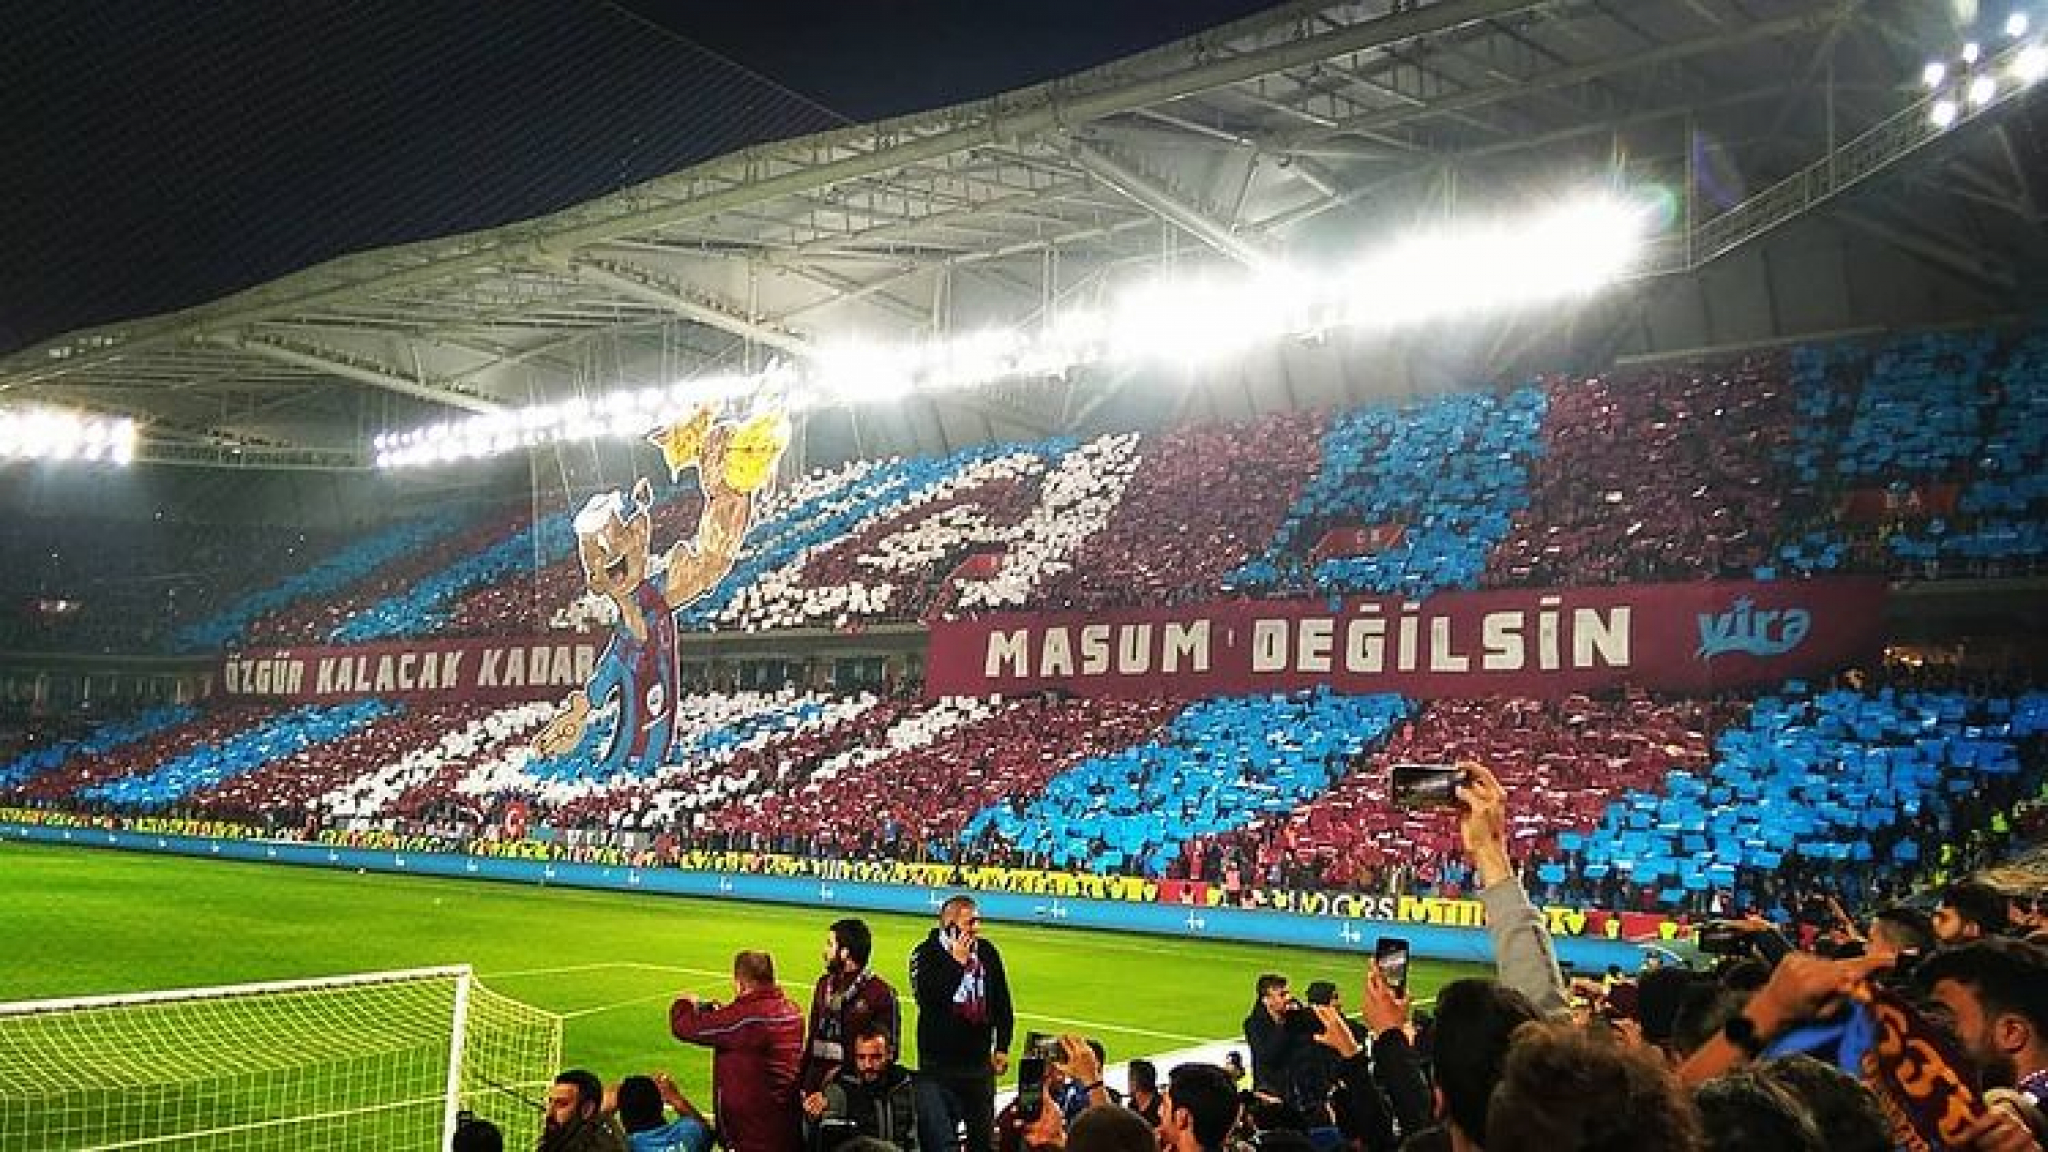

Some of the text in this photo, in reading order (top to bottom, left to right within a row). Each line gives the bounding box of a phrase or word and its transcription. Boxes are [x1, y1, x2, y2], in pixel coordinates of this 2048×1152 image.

[316, 649, 464, 694] KALACAK
[477, 644, 596, 686] KADAR
[985, 596, 1631, 678] MASUM DEĞİLSİN
